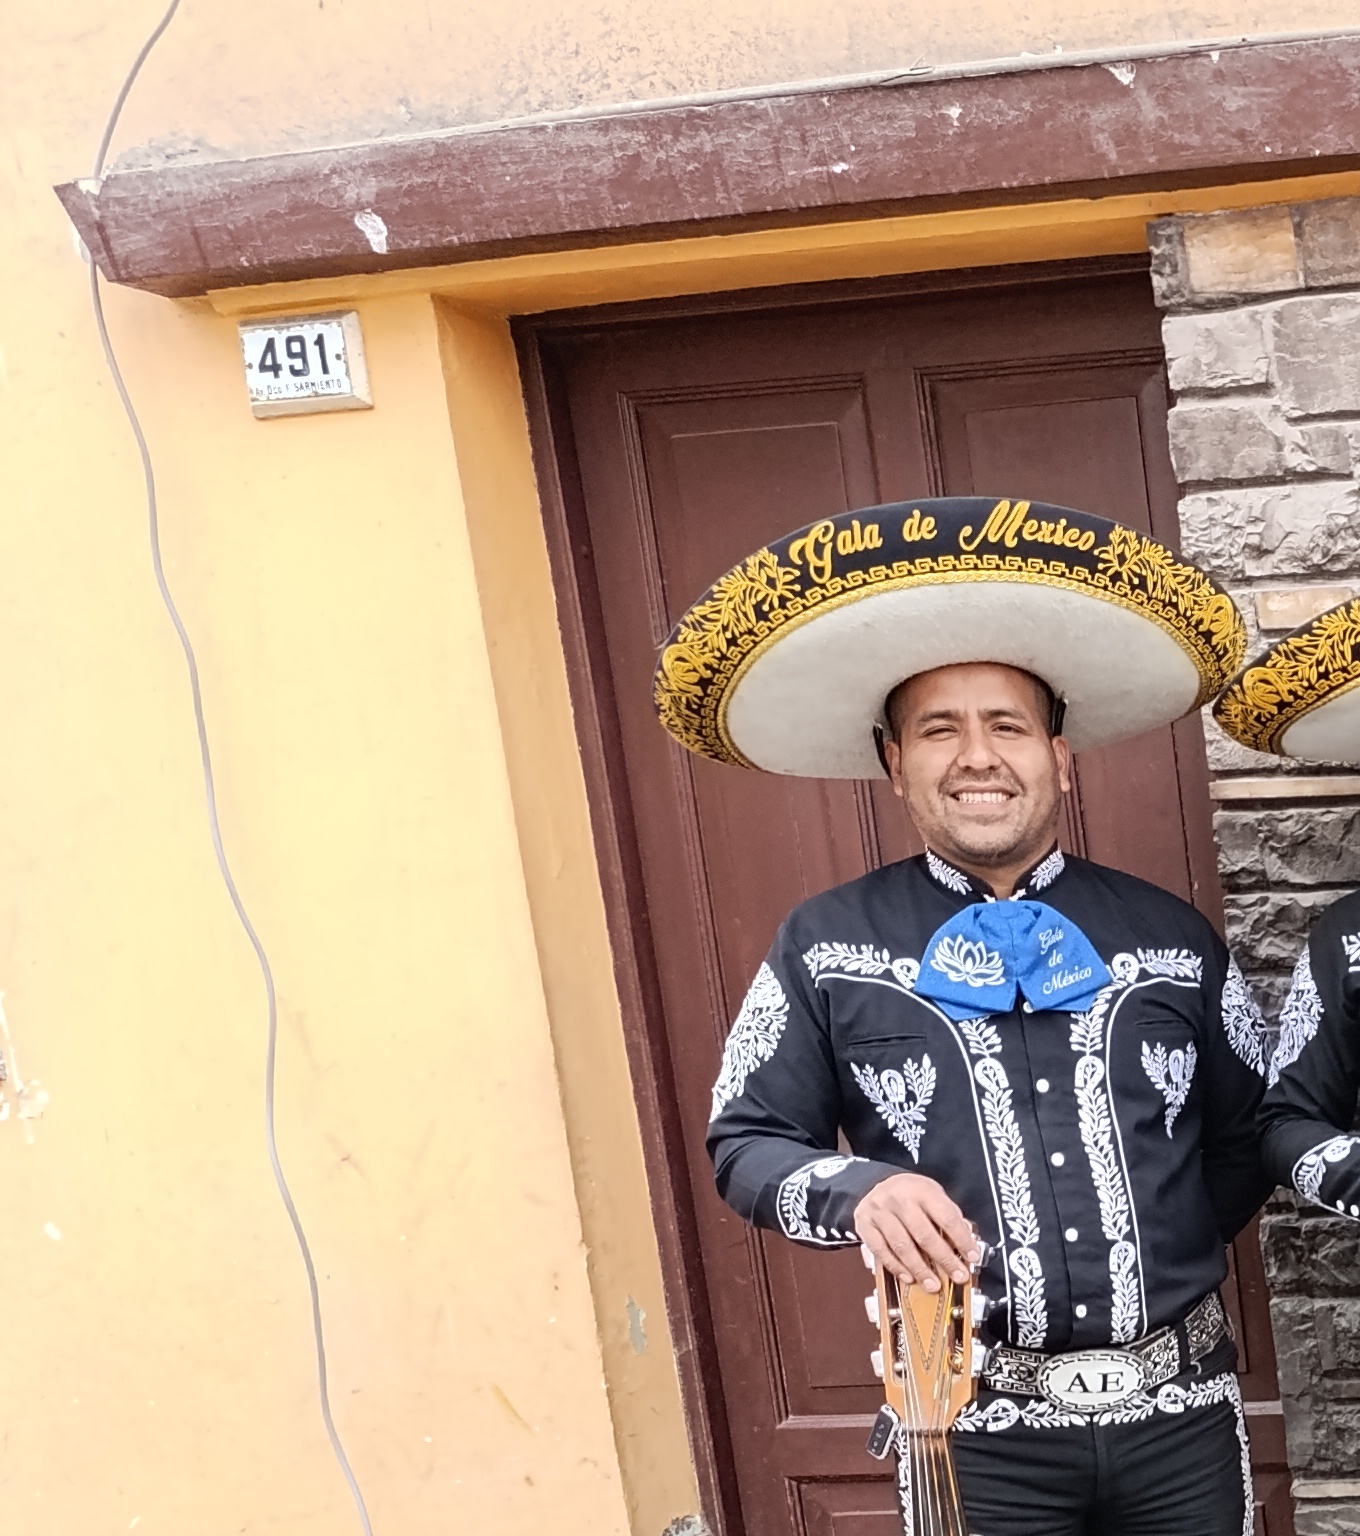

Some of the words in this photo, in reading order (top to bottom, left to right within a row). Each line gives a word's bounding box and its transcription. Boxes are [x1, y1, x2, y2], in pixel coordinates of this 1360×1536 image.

[258, 333, 330, 379] 491
[293, 379, 342, 393] SARMIENTO
[789, 520, 883, 585] Gala
[902, 509, 937, 541] de
[959, 499, 1097, 553] Mexico
[1049, 949, 1063, 968] de
